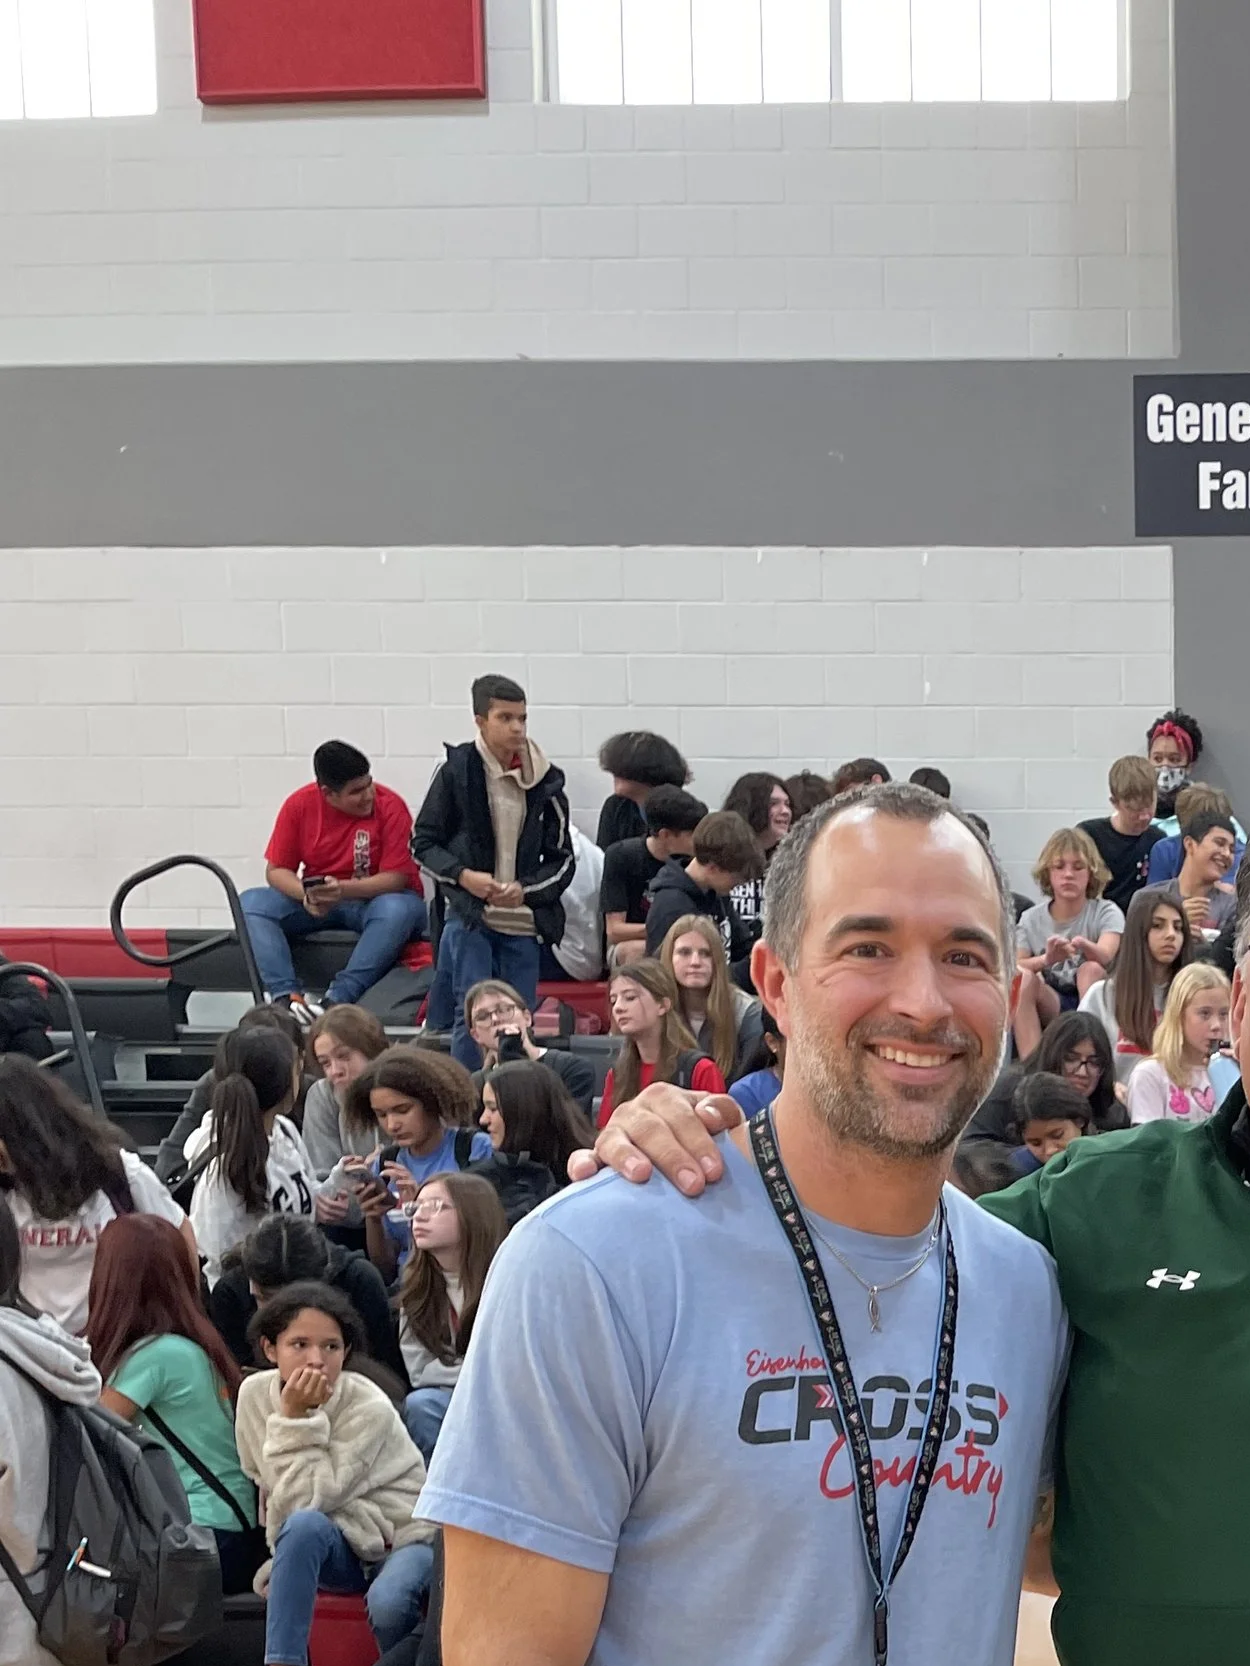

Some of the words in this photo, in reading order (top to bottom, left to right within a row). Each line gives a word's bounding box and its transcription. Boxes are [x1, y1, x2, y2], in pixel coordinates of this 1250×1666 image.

[745, 1344, 827, 1377] Eisenho
[737, 1375, 1001, 1446] CROSS
[818, 1428, 1004, 1529] Country
